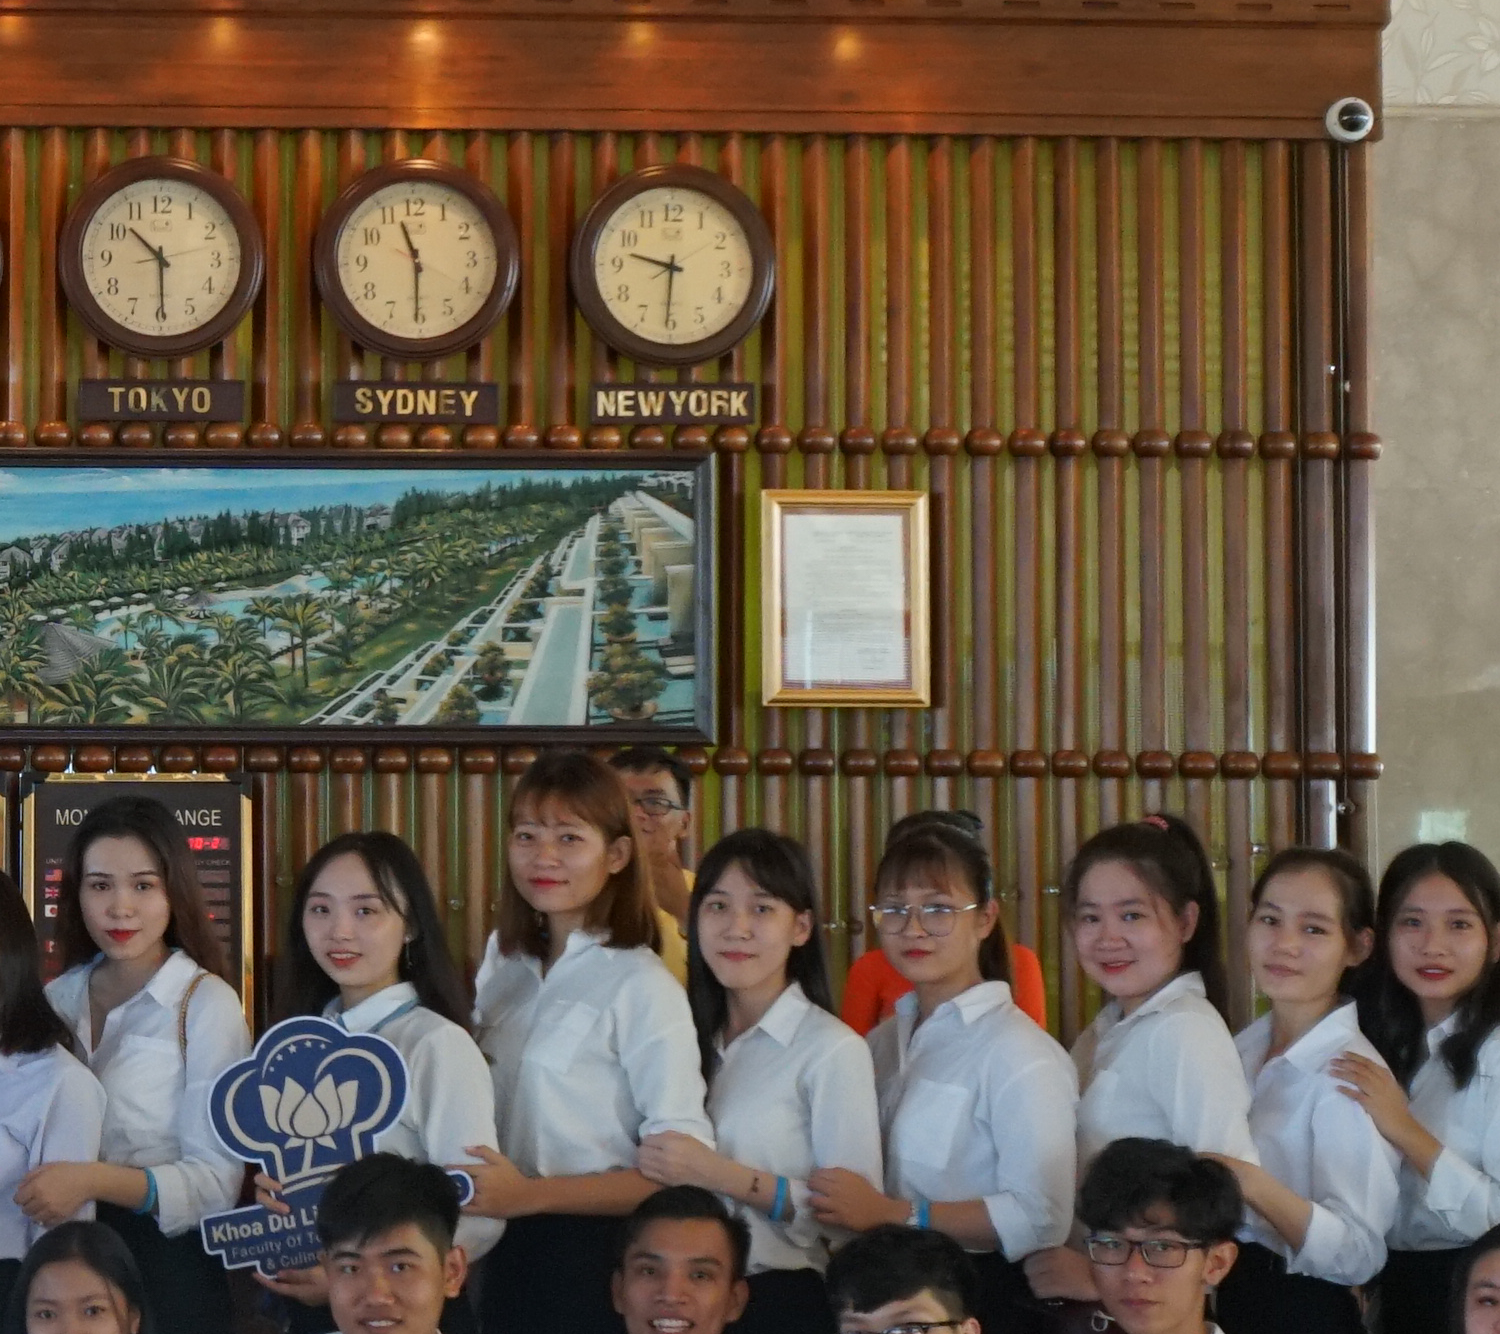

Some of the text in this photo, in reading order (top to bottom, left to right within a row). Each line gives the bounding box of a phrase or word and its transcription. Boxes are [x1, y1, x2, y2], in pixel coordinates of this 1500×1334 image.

[152, 195, 172, 214] 12
[404, 197, 424, 217] 12
[663, 204, 683, 223] 12
[108, 388, 212, 414] TOKYO
[354, 388, 479, 418] SYDNEY
[175, 809, 222, 826] ANGE
[211, 1221, 264, 1244] Khoa
[267, 1214, 296, 1233] Du
[231, 1241, 281, 1258] Faculty
[286, 1234, 302, 1248] Of
